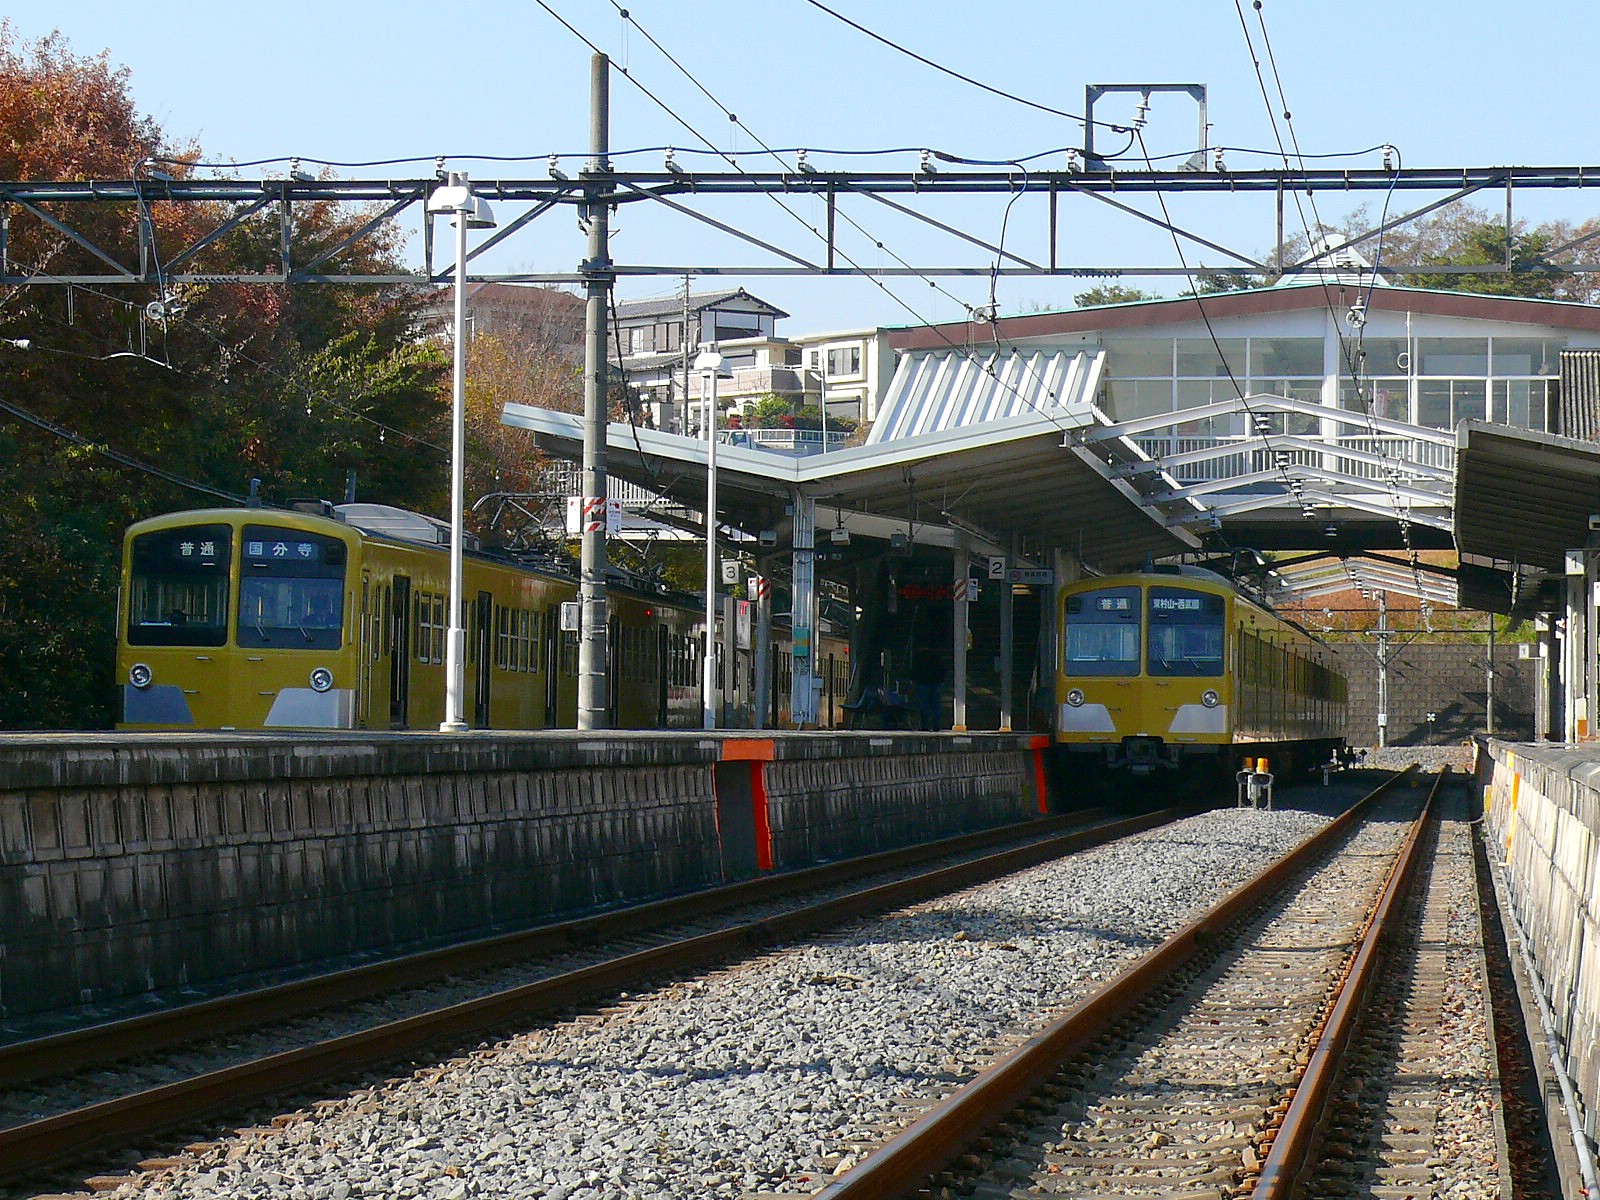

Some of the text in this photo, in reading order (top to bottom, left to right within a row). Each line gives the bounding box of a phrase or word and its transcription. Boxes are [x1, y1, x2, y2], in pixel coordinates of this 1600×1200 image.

[180, 542, 214, 556] 普通
[250, 542, 312, 557] 国分寺
[992, 561, 1002, 574] 2
[1571, 555, 1577, 569] 1
[726, 566, 736, 579] 3
[1101, 598, 1128, 610] 普通
